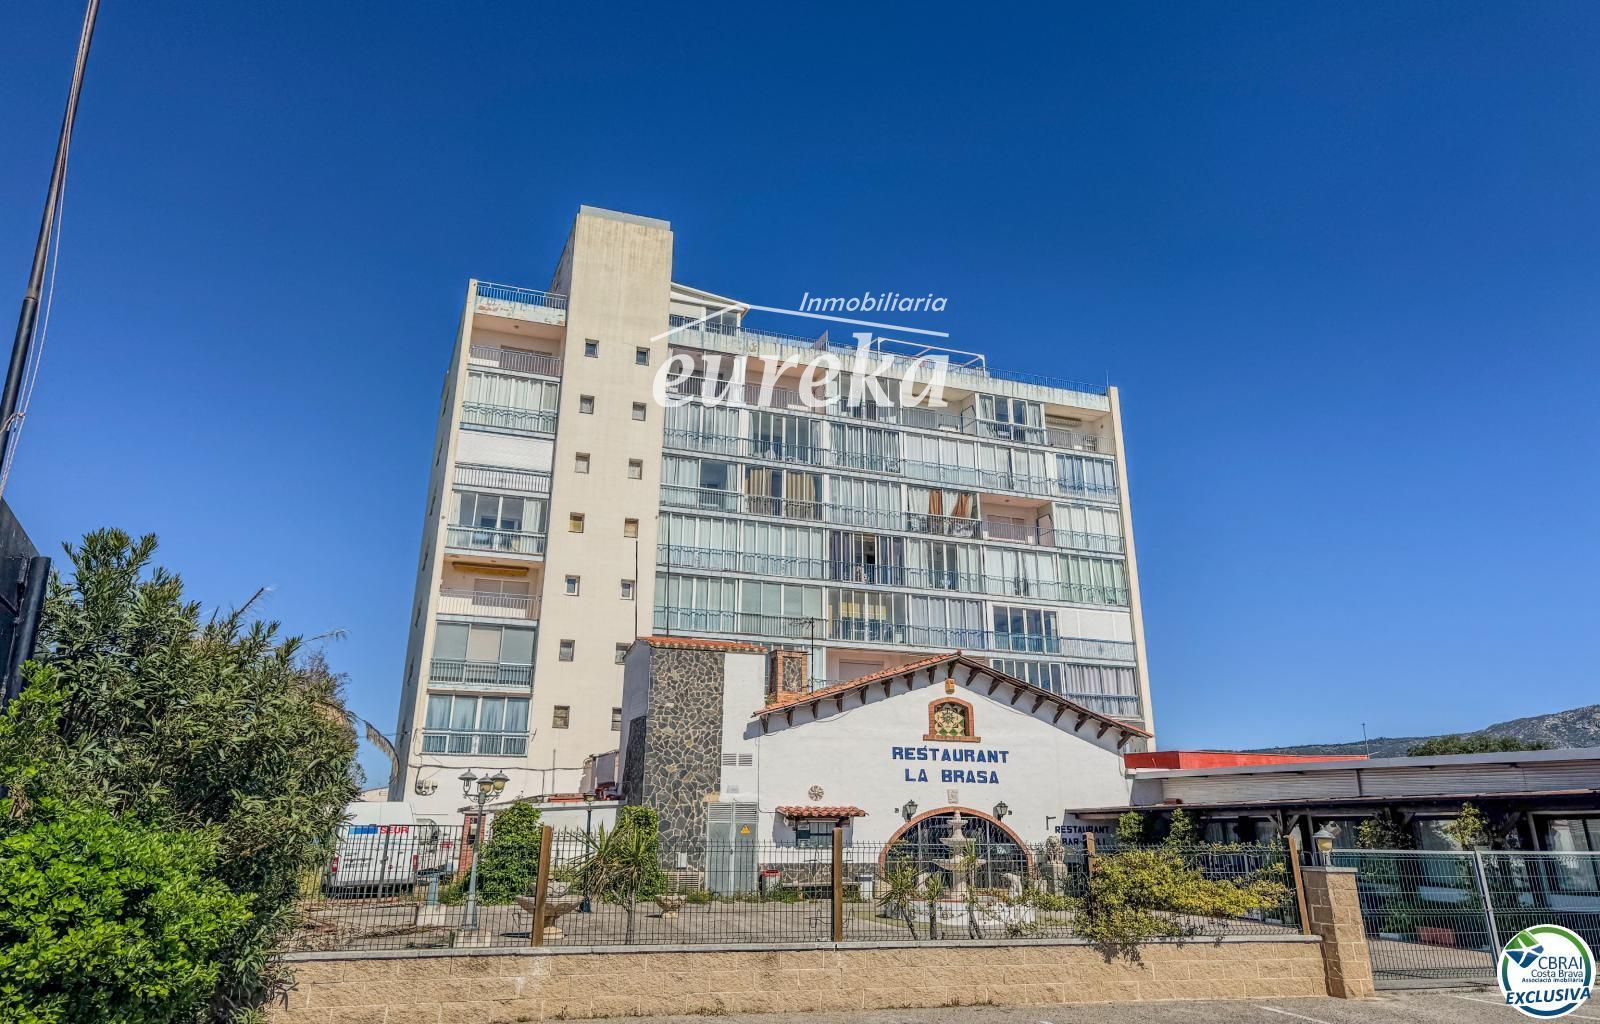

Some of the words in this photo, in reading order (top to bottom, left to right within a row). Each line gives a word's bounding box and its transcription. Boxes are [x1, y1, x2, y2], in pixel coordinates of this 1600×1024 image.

[892, 746, 1009, 763] RESTAURANT
[904, 768, 928, 782] LA
[941, 769, 999, 784] BRASA
[380, 825, 409, 834] SEUR
[1055, 826, 1109, 834] RESTAURANT
